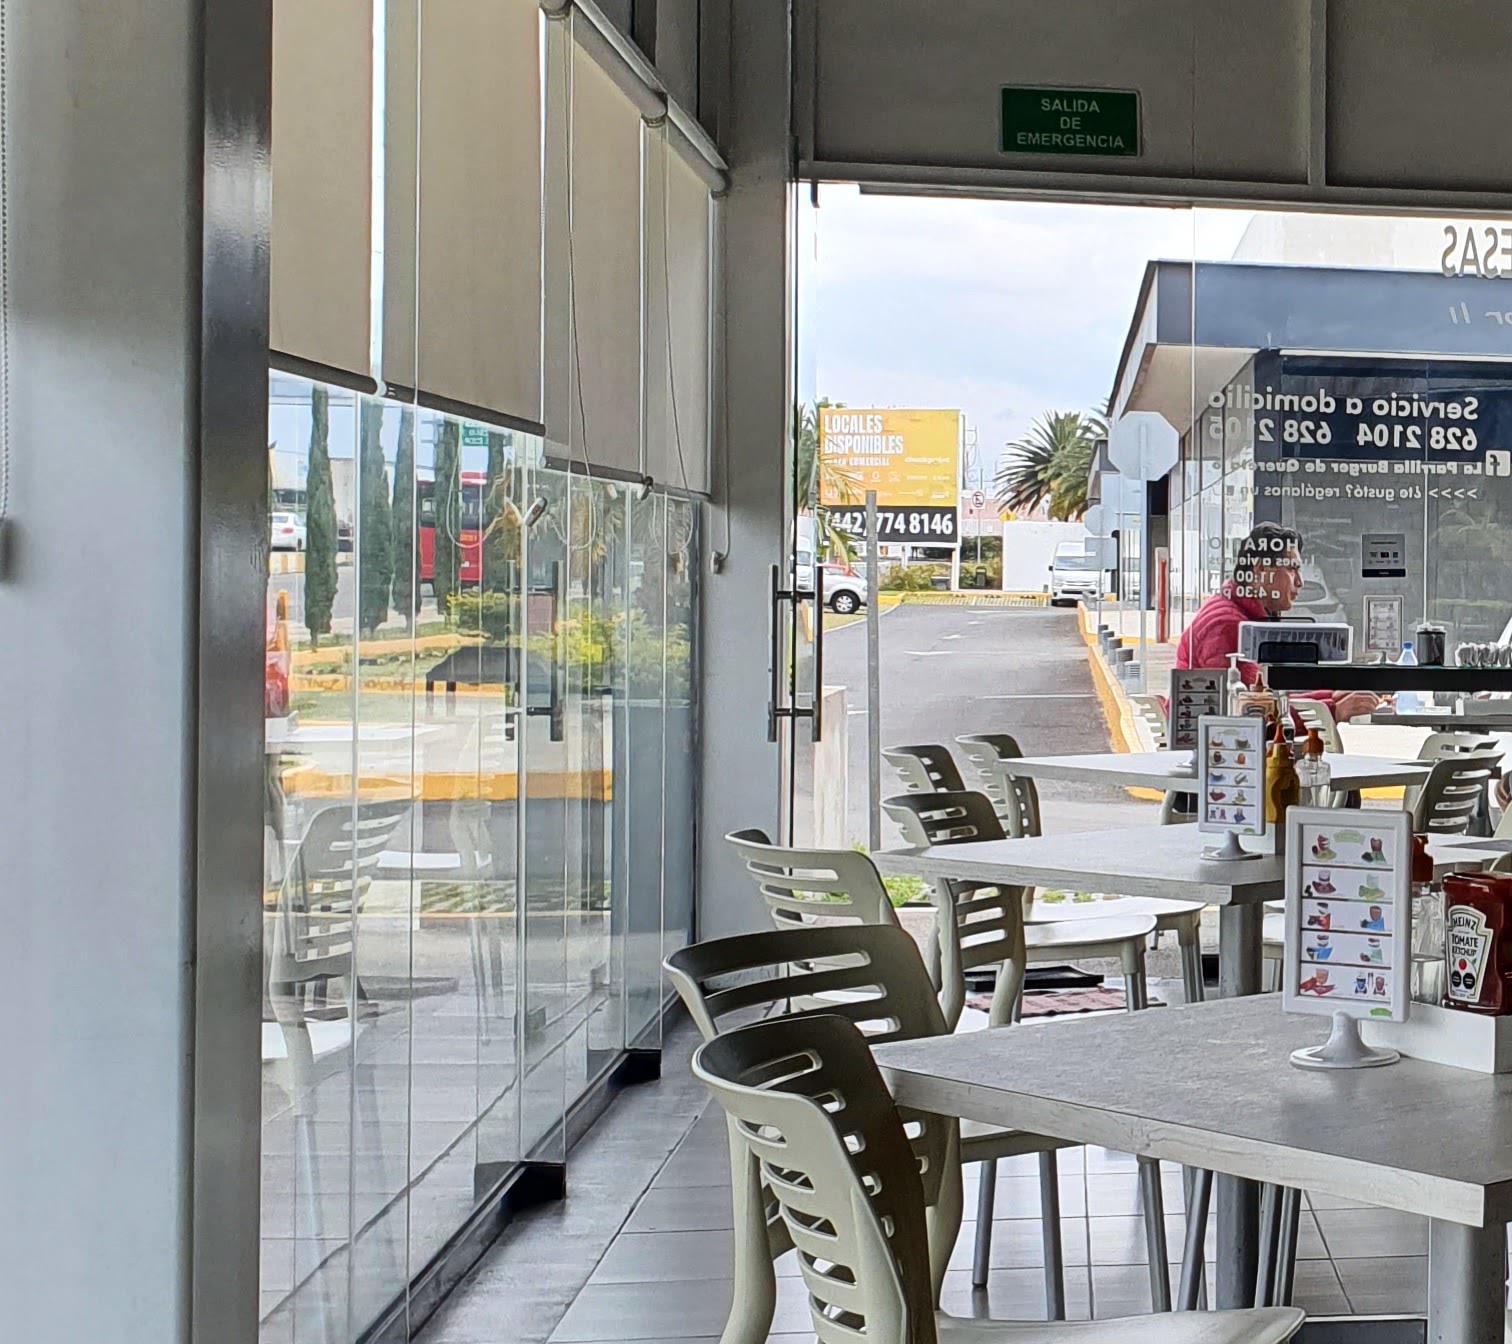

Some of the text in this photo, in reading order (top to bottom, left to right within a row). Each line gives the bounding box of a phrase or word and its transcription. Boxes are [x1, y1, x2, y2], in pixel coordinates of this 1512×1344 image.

[1041, 98, 1100, 113] SALIDA
[1060, 117, 1081, 129] DE
[1017, 132, 1125, 148] EMERGENCIA
[824, 414, 883, 434] LOCALES
[824, 435, 904, 454] DISPONIBLES
[909, 512, 953, 535] 8146
[1453, 916, 1477, 931] HEINZ
[1451, 934, 1479, 948] TOMATE
